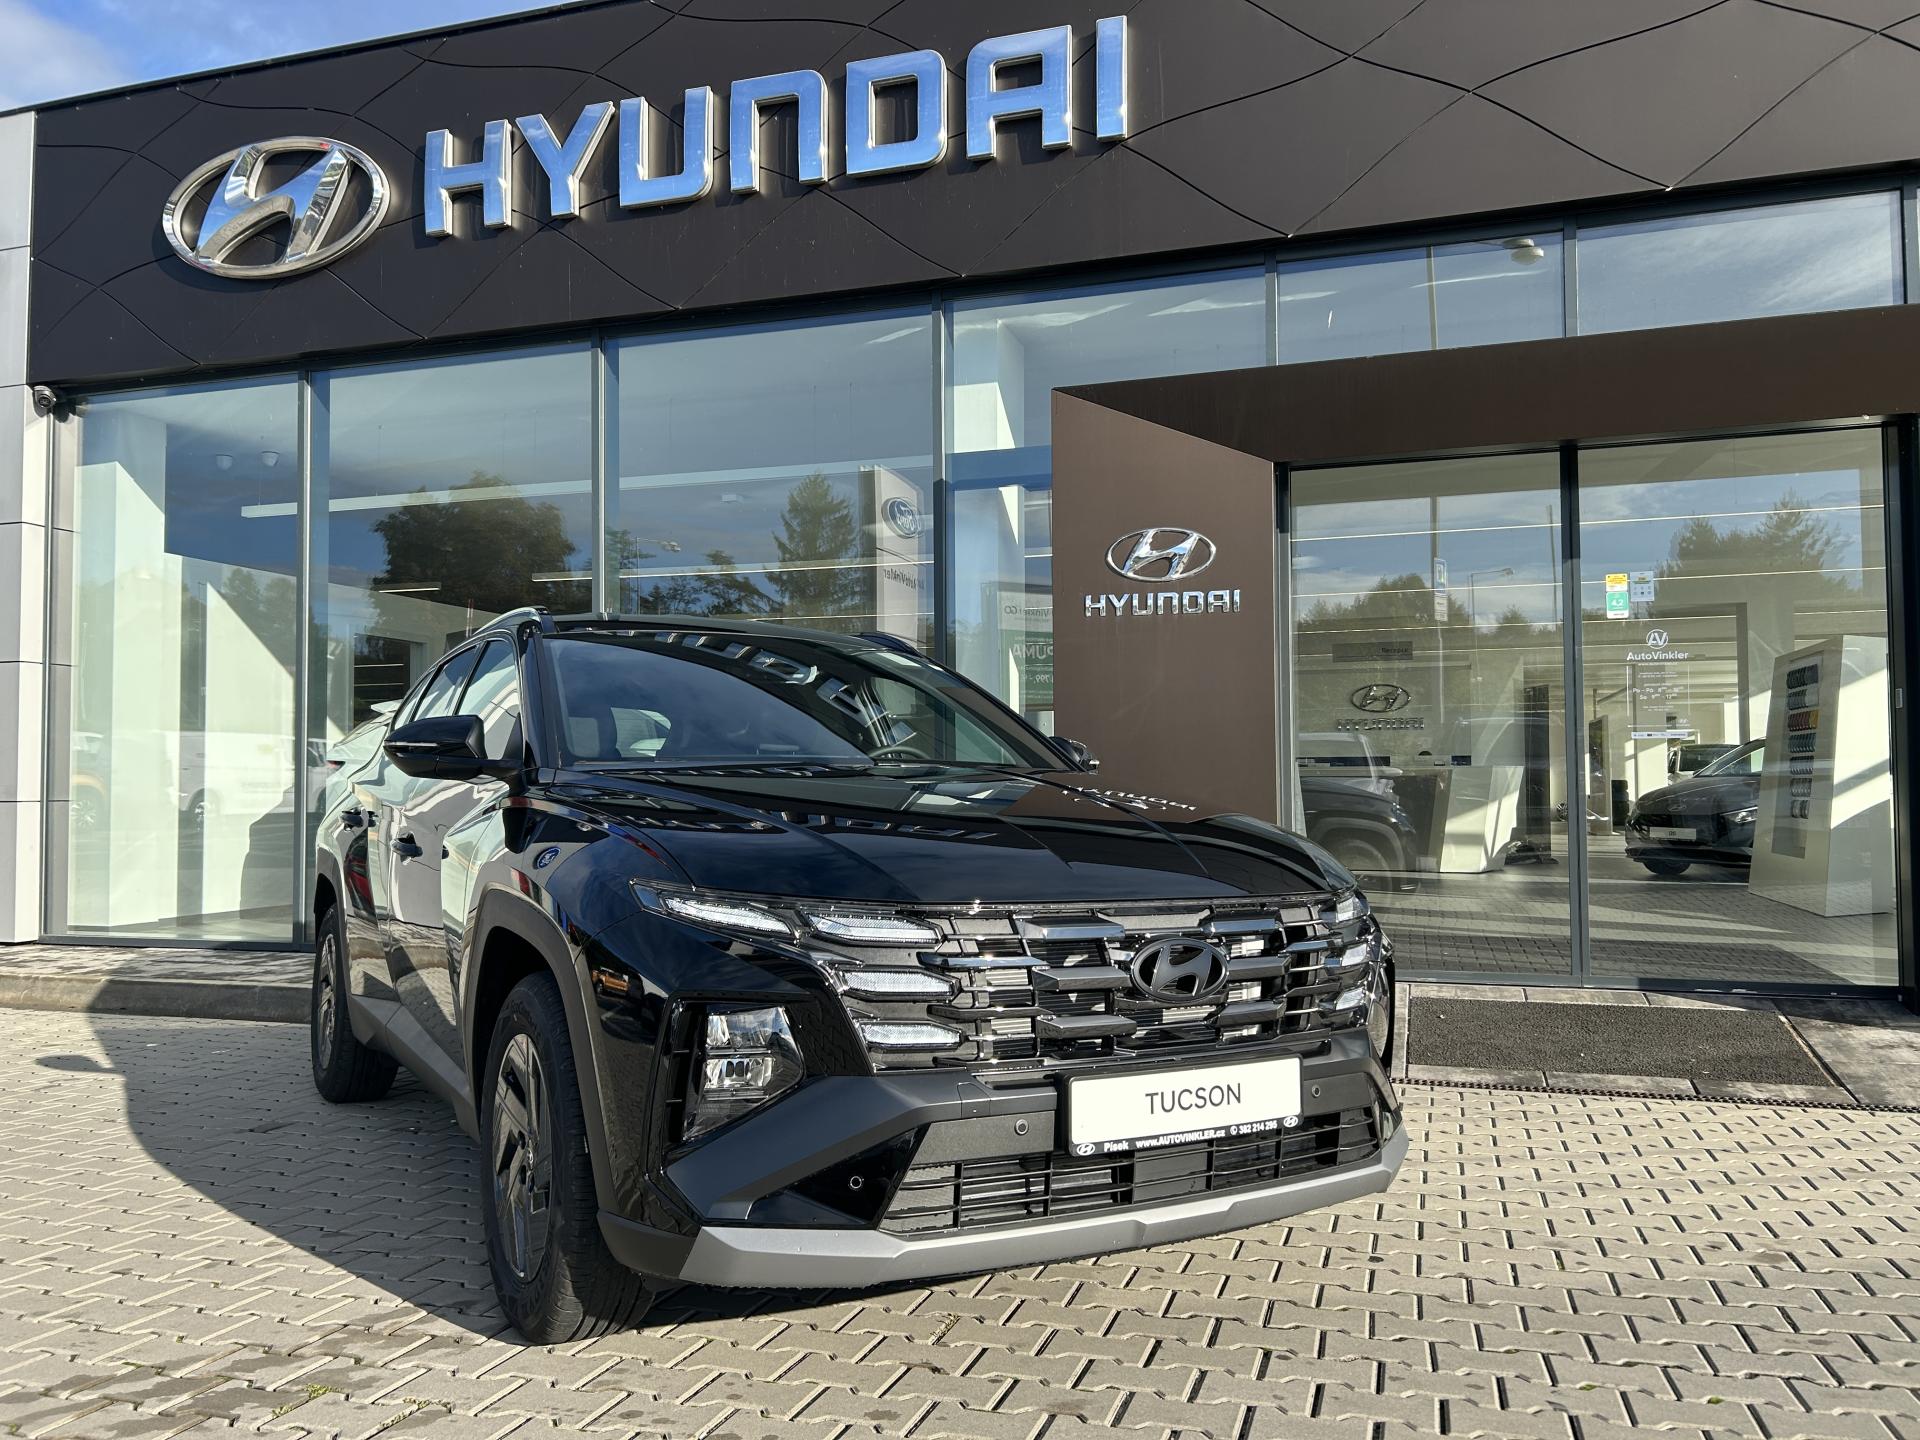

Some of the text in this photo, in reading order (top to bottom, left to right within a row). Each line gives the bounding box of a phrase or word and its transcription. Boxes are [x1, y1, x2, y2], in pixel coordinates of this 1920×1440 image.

[424, 14, 1128, 238] HYUNDAI
[1084, 589, 1241, 617] HYUNDAI
[1626, 650, 1689, 661] AutoVinkler
[1145, 1082, 1241, 1115] TUCSON
[1135, 1128, 1226, 1149] www.AUTOVINKLER.cz
[1252, 1121, 1265, 1132] 214
